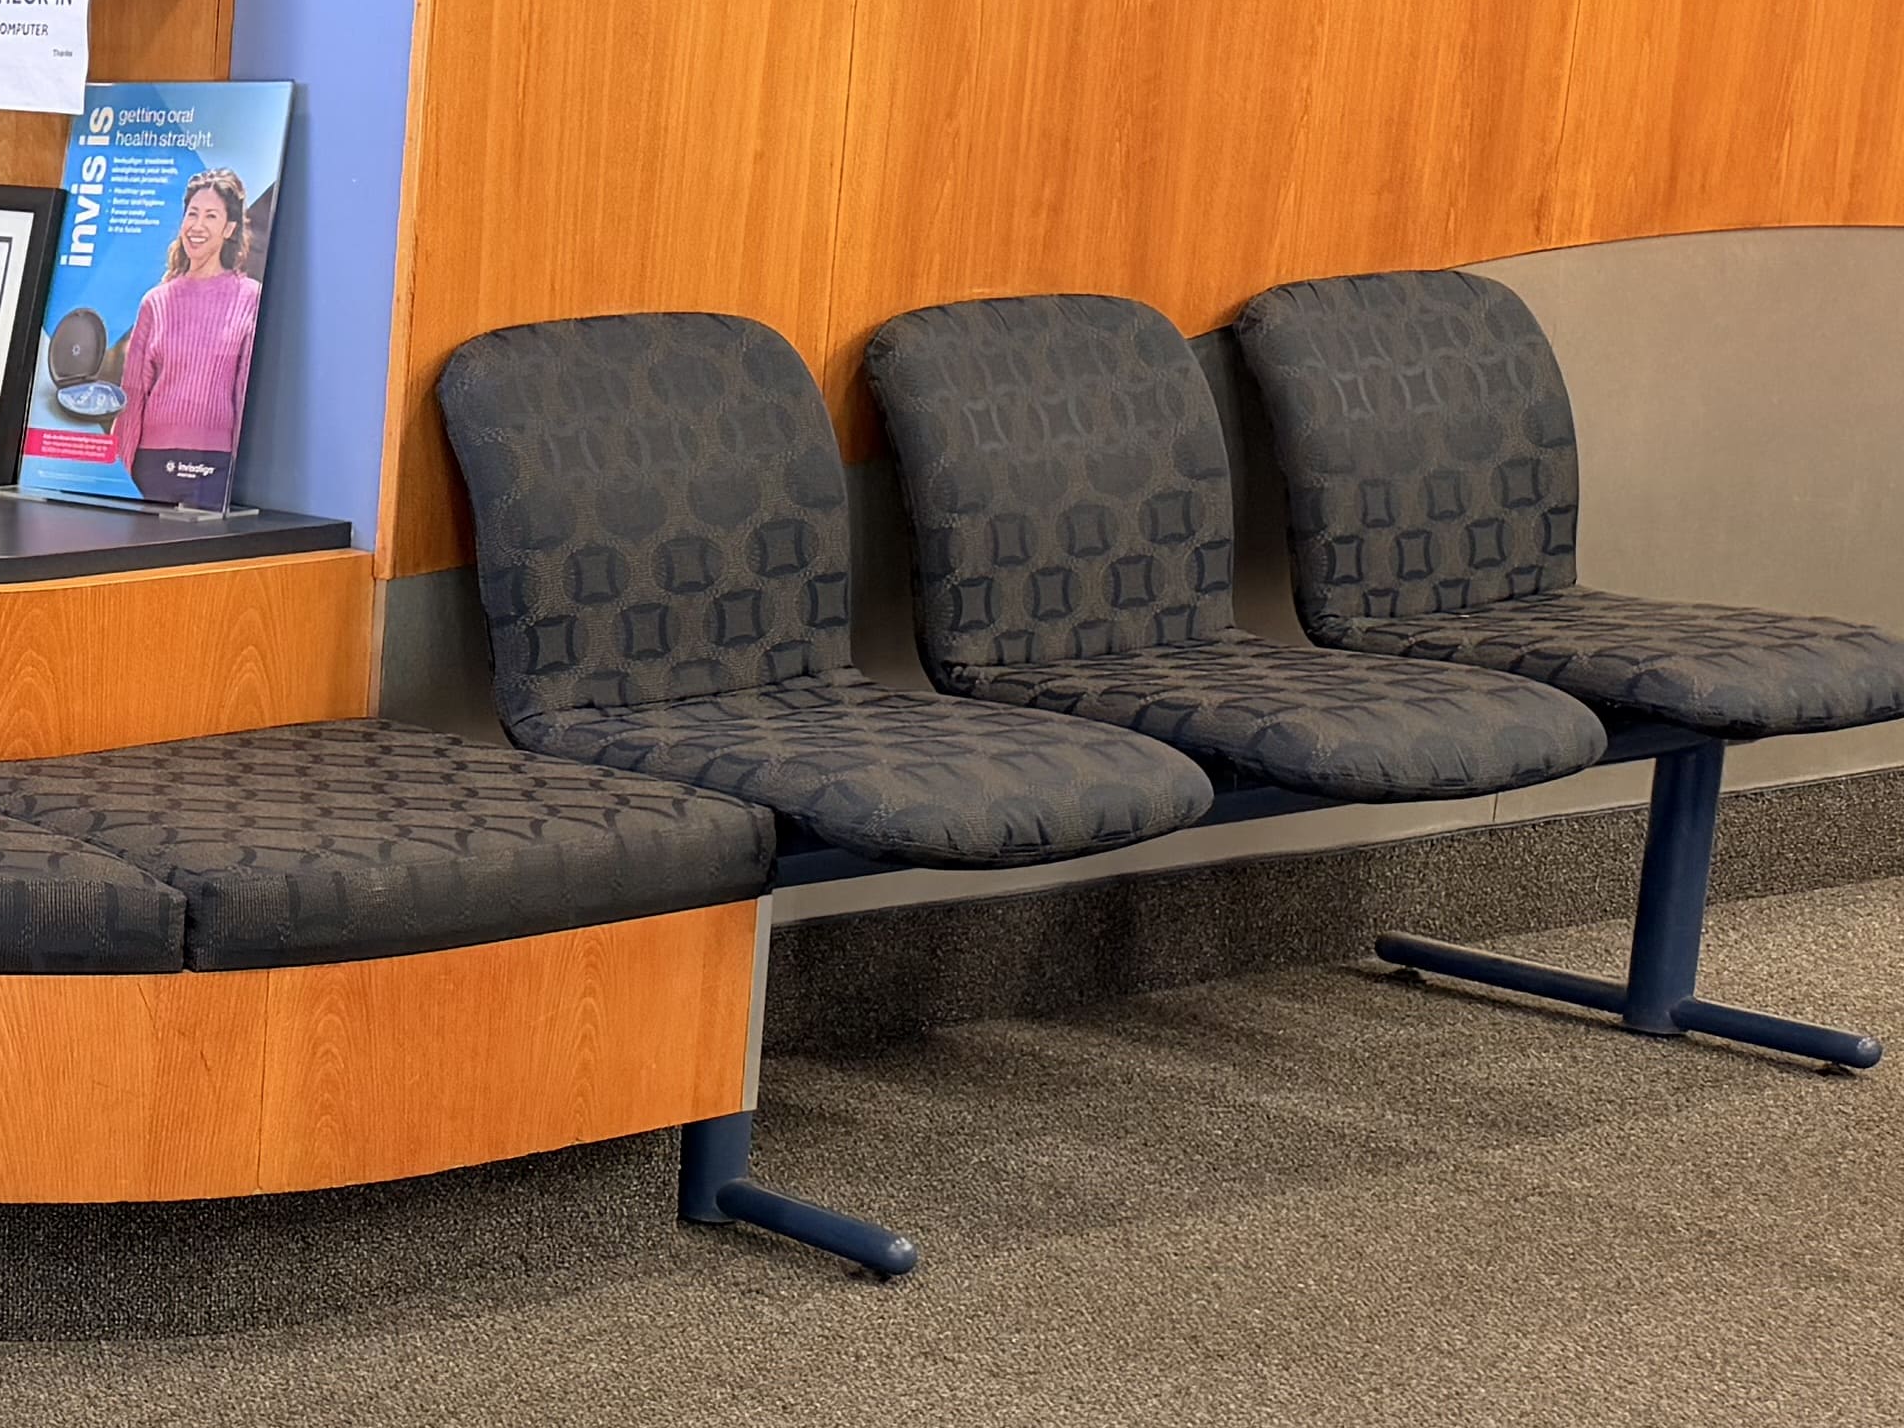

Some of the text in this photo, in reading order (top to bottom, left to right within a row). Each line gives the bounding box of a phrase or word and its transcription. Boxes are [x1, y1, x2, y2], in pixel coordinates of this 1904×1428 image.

[119, 107, 194, 126] getting oral
[115, 130, 213, 150] health straight.
[60, 106, 114, 267] invis is
